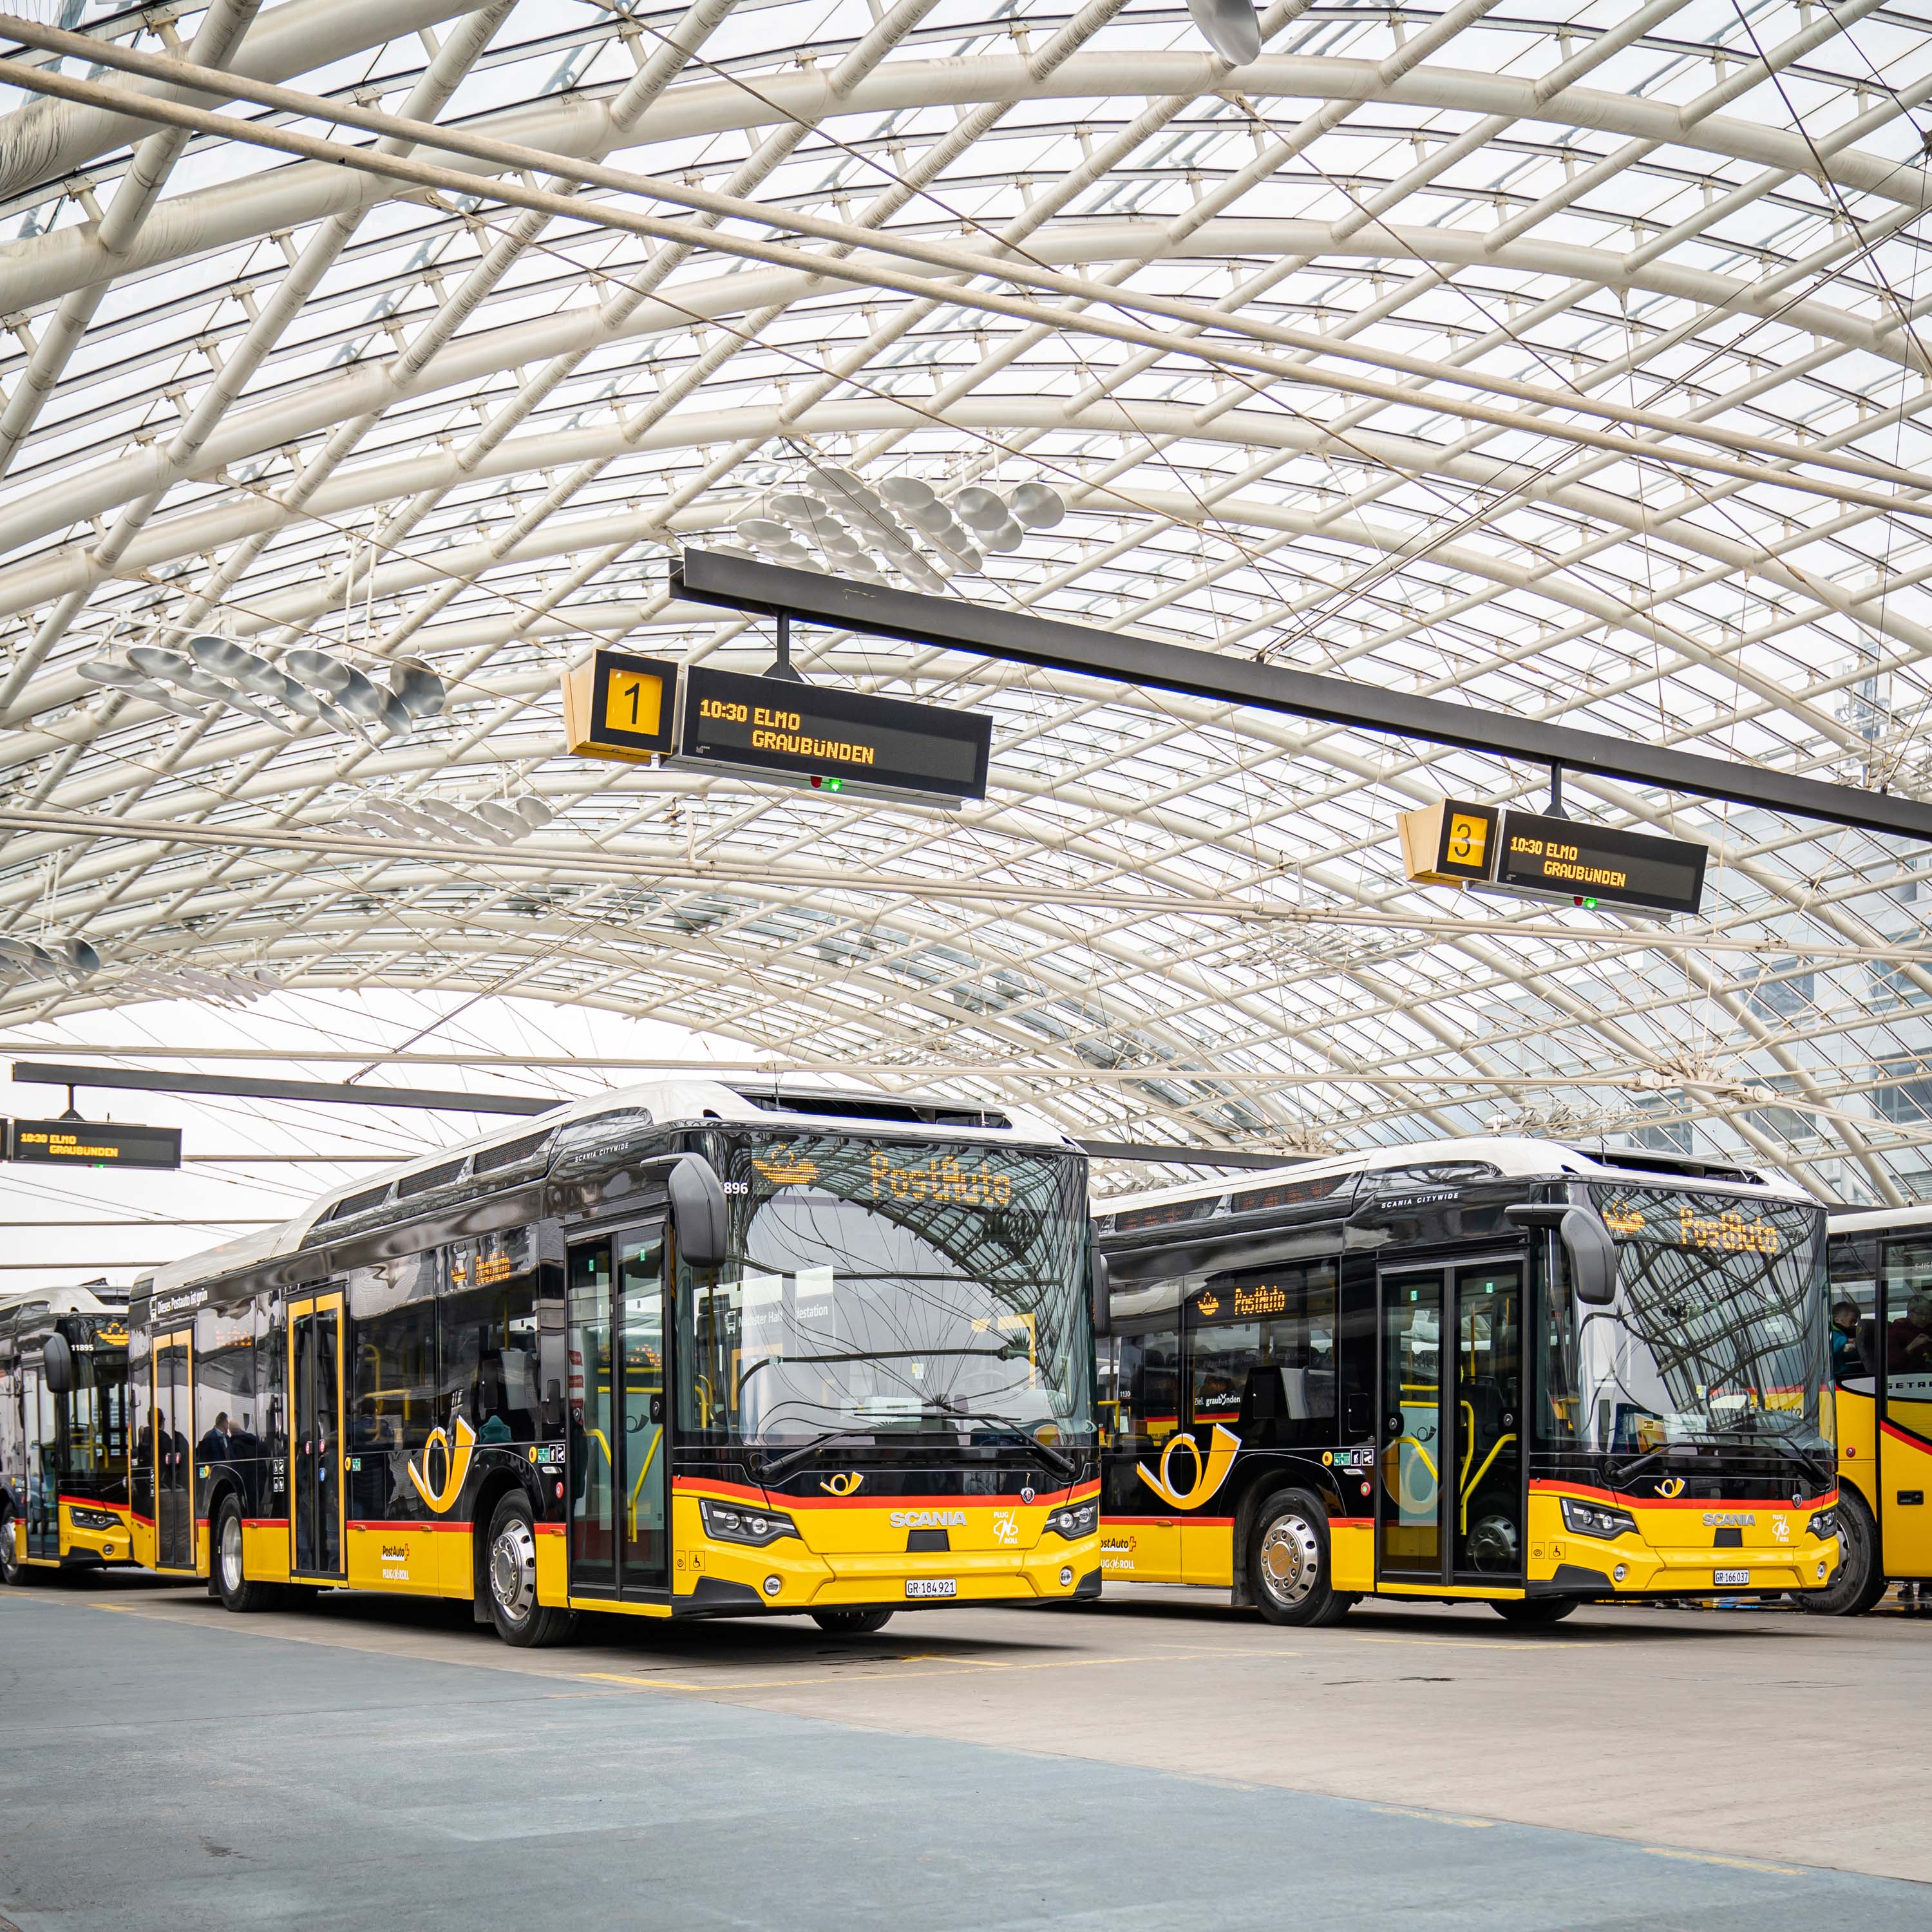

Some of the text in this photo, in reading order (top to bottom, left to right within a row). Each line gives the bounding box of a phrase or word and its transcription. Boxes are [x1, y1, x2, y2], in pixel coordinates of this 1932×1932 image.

[624, 682, 639, 724] 1
[699, 699, 800, 730] 10:30 ELMO
[752, 730, 874, 764] GRAUBÜNDEN
[1454, 824, 1471, 857] 3
[1510, 837, 1578, 860] 10:30 ELMO
[1543, 861, 1626, 887] GRAUBÜNDEN
[21, 1133, 77, 1144] 10:30 ELMO
[574, 1142, 629, 1162] SCANIA CITYWIDE
[871, 1151, 1010, 1204] PostAuto
[721, 1182, 748, 1195] 896
[1381, 1192, 1459, 1209] SCANIA CITYWIDE
[1680, 1205, 1777, 1253] PostAuto
[158, 1300, 171, 1314] Dieses
[196, 1288, 207, 1306] grün
[768, 1309, 782, 1322] Halt
[1888, 1381, 1932, 1389] SETR
[889, 1511, 967, 1528] SCANIA
[1703, 1512, 1756, 1526] SCANIA
[383, 1545, 404, 1557] PostAuto
[1121, 1559, 1135, 1569] ROLL
